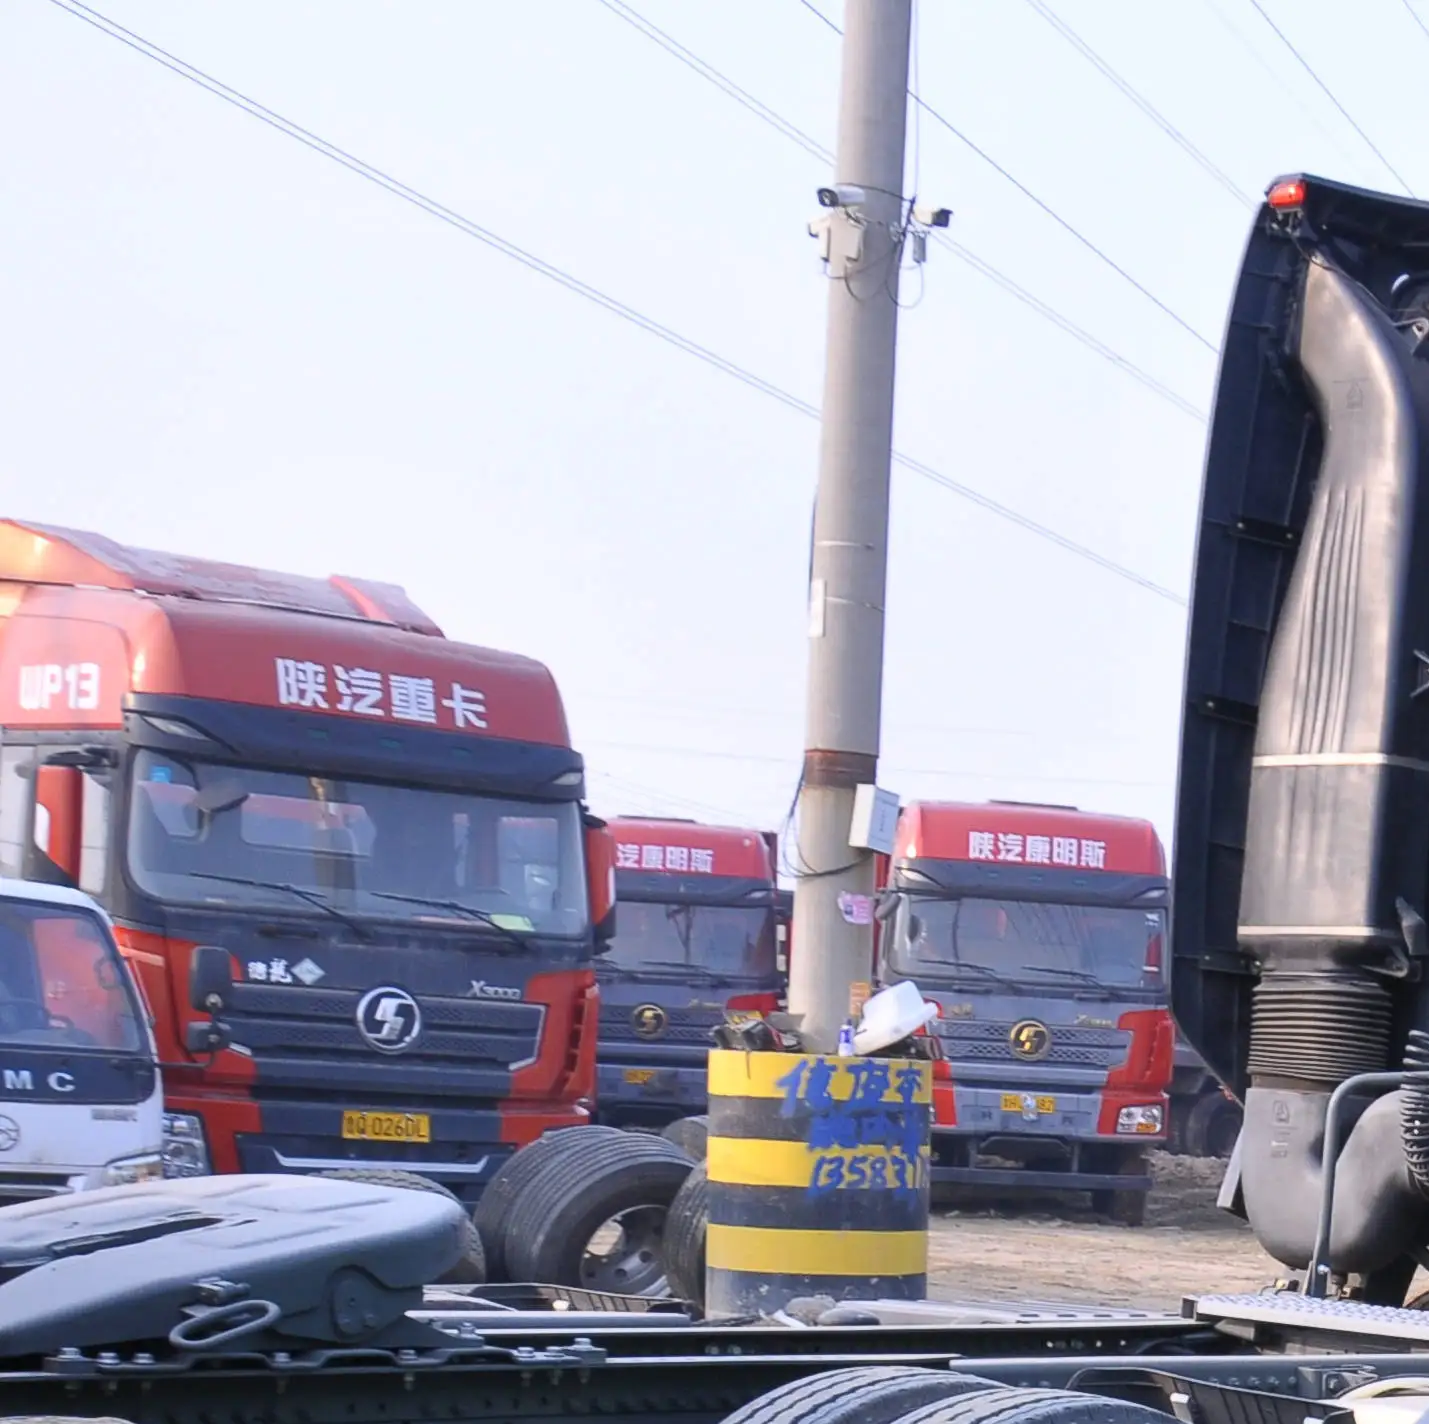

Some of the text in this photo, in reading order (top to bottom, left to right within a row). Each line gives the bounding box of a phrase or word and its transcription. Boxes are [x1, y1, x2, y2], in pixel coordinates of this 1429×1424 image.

[275, 656, 488, 729] 陕汽重卡
[968, 830, 1107, 871] 陕汽康明斯
